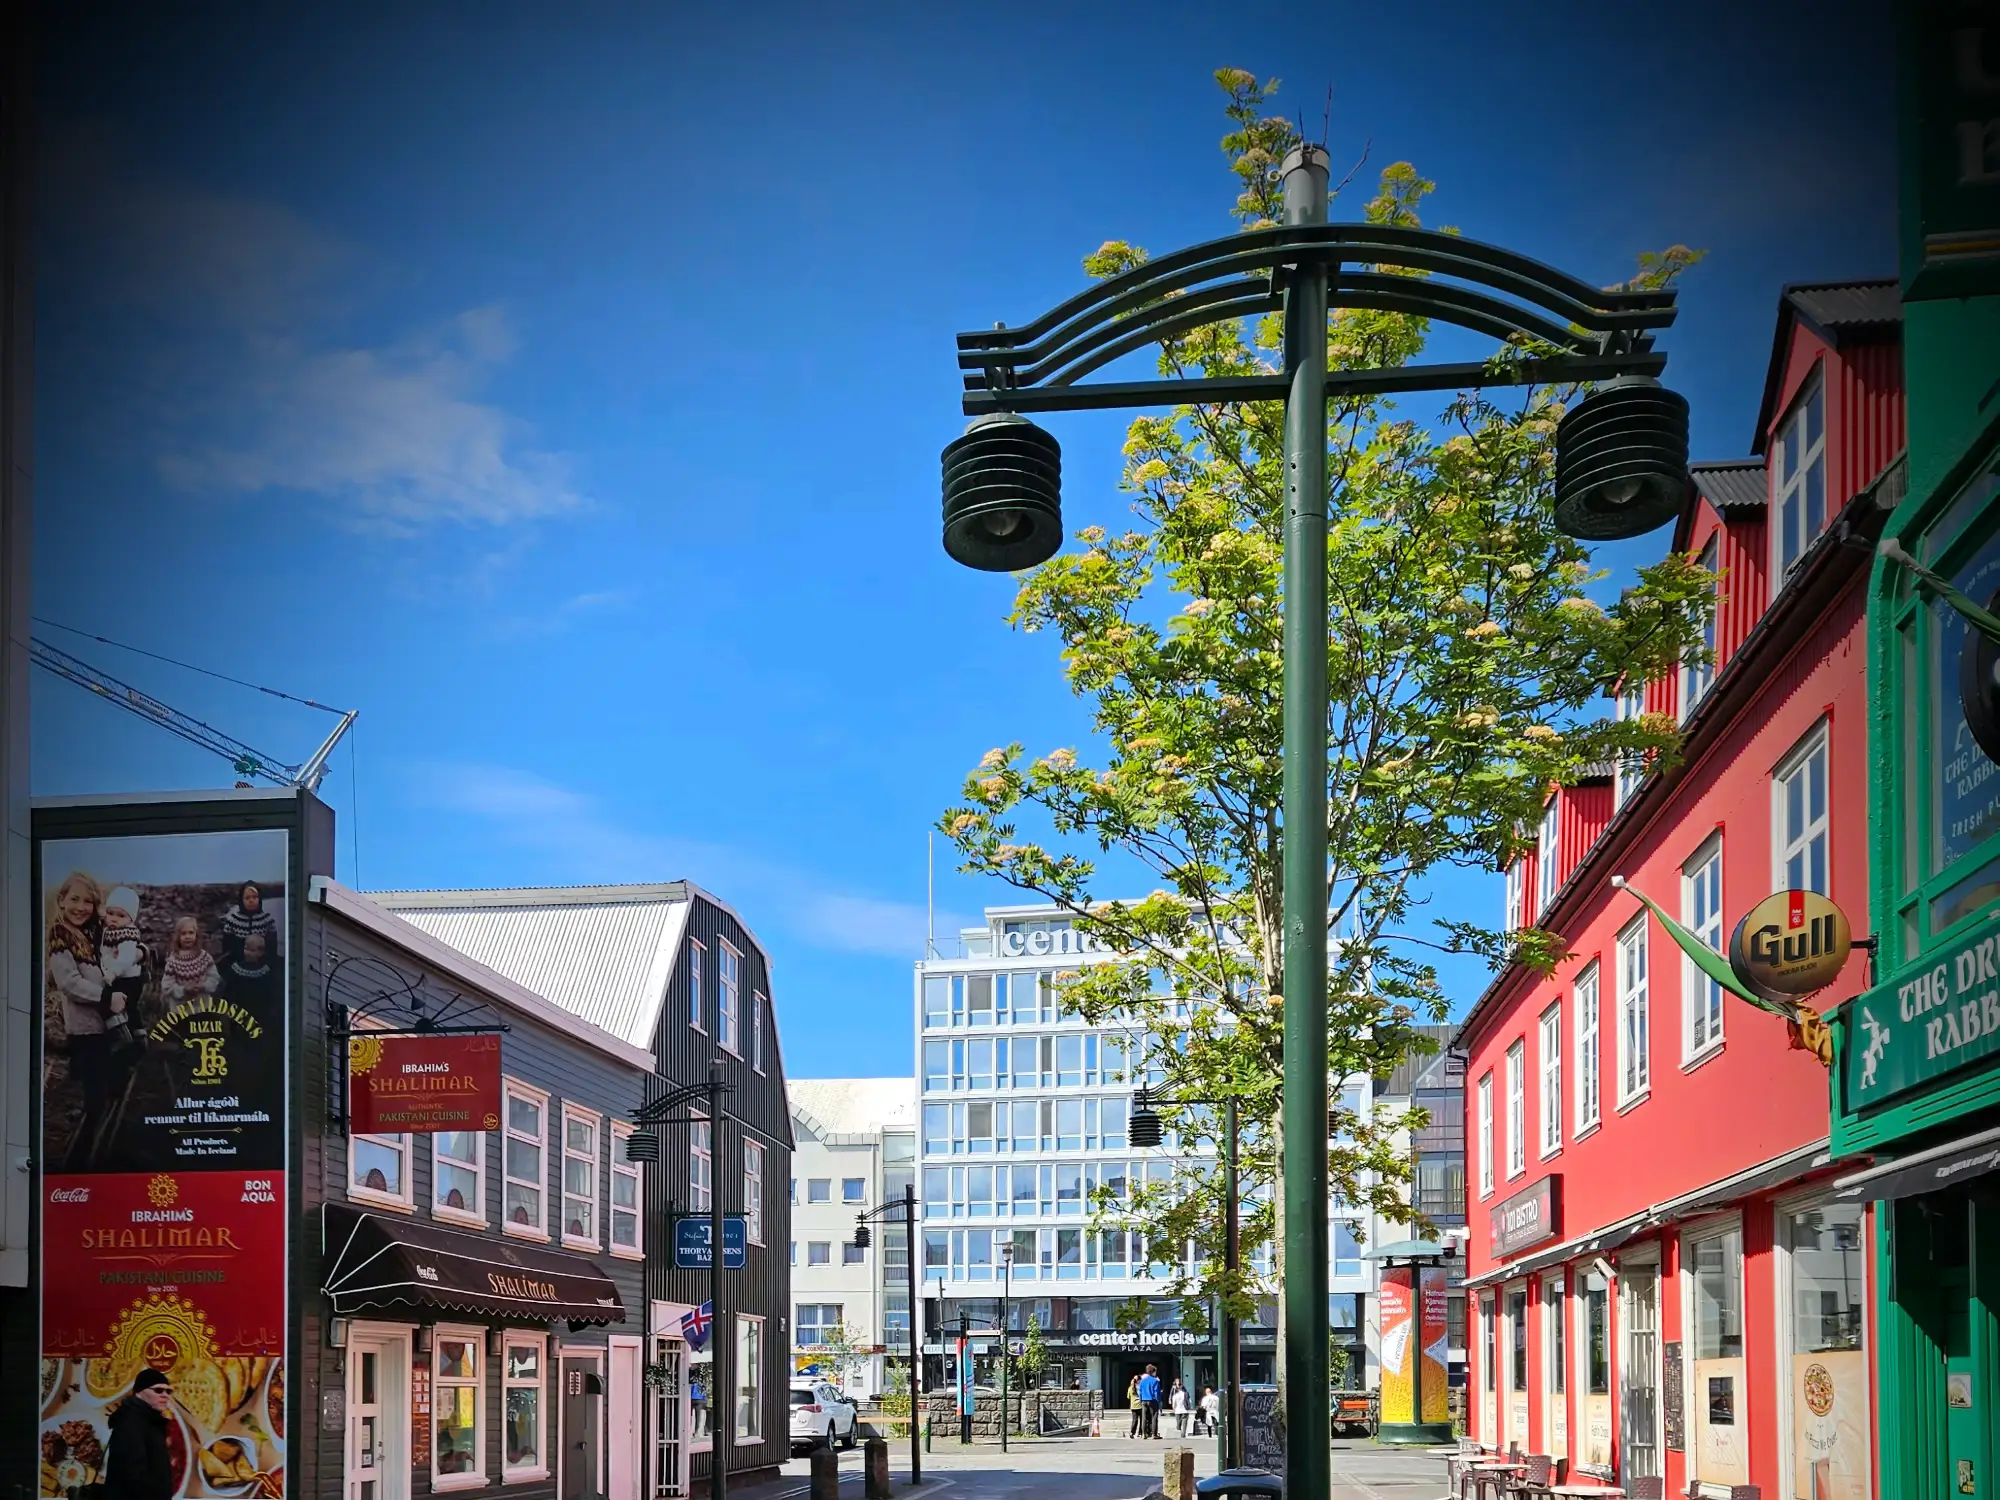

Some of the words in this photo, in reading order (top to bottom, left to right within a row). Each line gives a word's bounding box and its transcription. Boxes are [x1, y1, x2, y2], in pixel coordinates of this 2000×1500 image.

[1945, 751, 1969, 784] THE
[1951, 810, 1983, 838] IRISH
[1751, 914, 1837, 968] Gull
[1898, 963, 1949, 1023] THE
[149, 996, 263, 1043] THORVALDSENS
[189, 1020, 223, 1034] BAZAR
[402, 1061, 450, 1074] IBRAHIM'S
[174, 1097, 206, 1109] Allur
[207, 1096, 240, 1110] ágóði
[144, 1114, 187, 1124] rennur
[188, 1112, 202, 1123] til
[204, 1110, 270, 1123] líknarmála
[379, 1112, 430, 1123] PAKISTANI
[431, 1110, 470, 1122] CUISINE
[182, 1138, 194, 1146] All
[245, 1179, 272, 1191] BON
[240, 1191, 276, 1204] AQUA
[131, 1207, 194, 1223] IBRAHIM'S
[1516, 1198, 1538, 1228] BISTRO
[679, 1247, 742, 1255] THORVASENS
[99, 1271, 169, 1285] PAKISTANI
[171, 1270, 225, 1283] CUISINE
[1079, 1331, 1137, 1346] center
[1138, 1329, 1195, 1346] hotels
